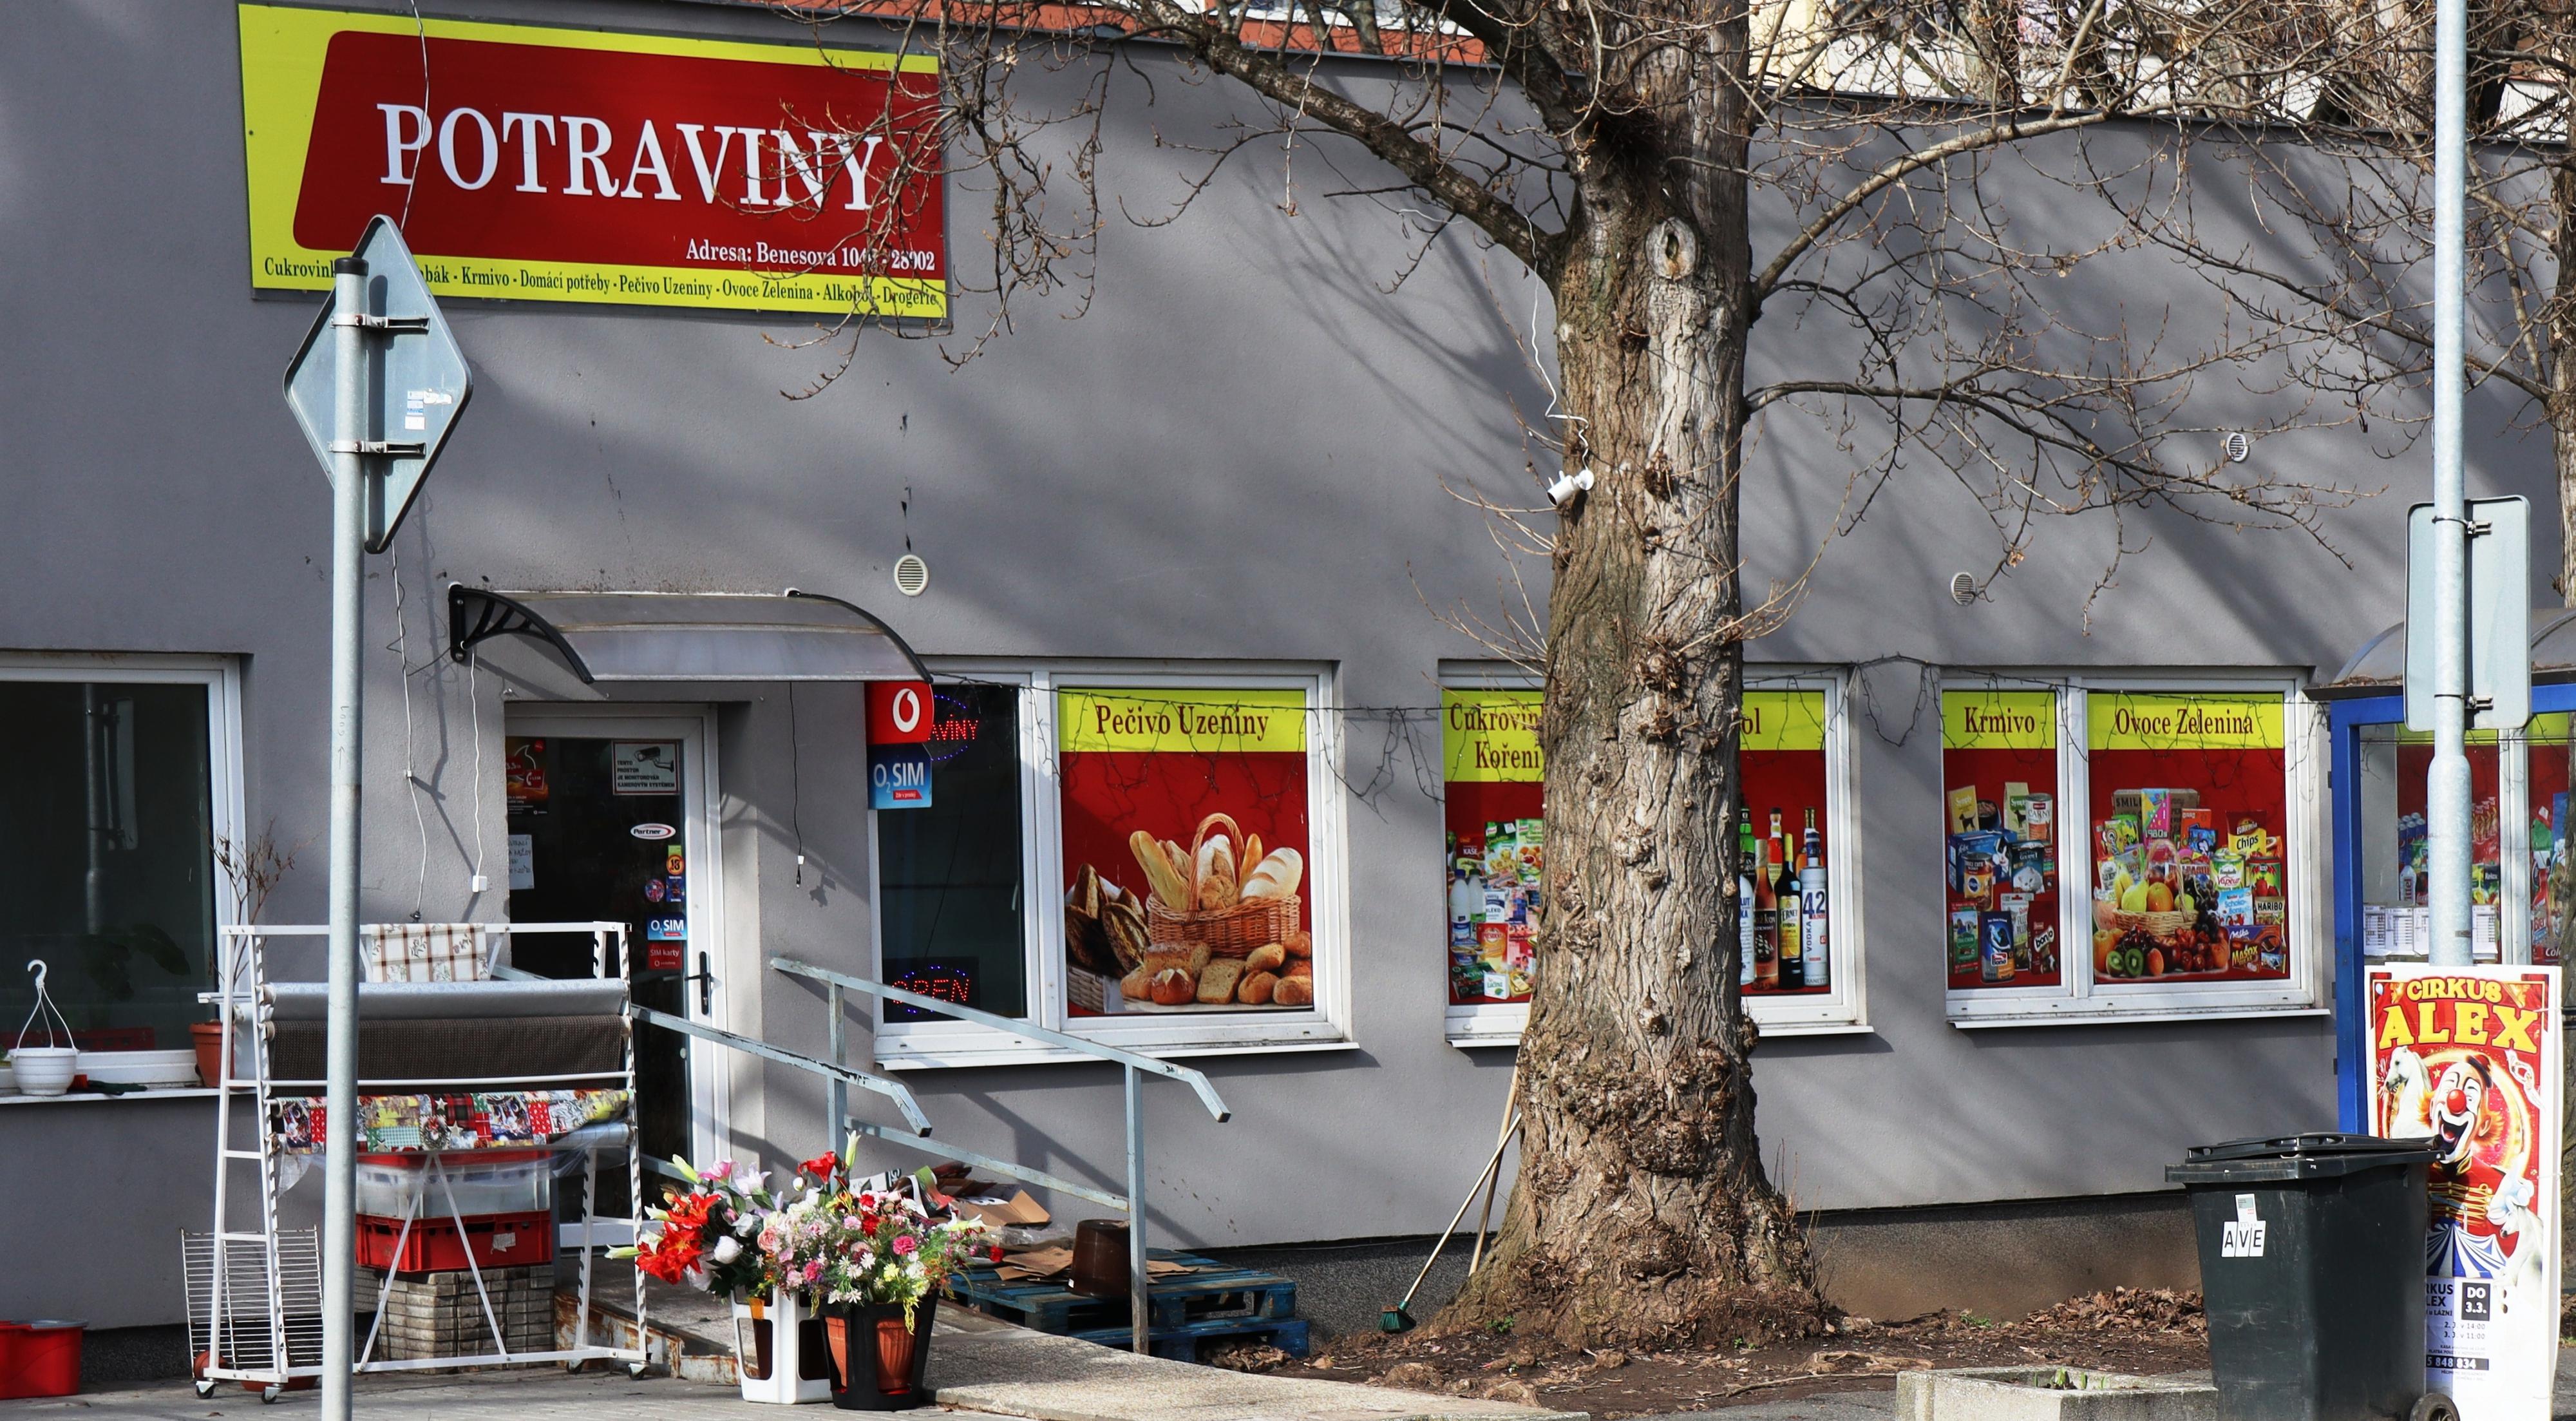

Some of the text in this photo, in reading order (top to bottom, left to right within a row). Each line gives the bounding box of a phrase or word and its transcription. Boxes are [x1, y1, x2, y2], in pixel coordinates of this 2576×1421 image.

[377, 103, 882, 211] POTRAVINY
[686, 238, 752, 263] Adresa:
[756, 242, 837, 267] Benesova
[462, 266, 509, 287] Krmivo
[520, 269, 563, 289] Domácí
[567, 272, 611, 294] potřeby
[619, 275, 659, 294] Pečivo
[663, 277, 712, 300] Uzeniny
[723, 279, 759, 297] Ovoce
[762, 281, 813, 300] Zelenina
[823, 283, 872, 303] Alkohol
[1096, 705, 1269, 741] Pečivo Uzeniny
[1964, 707, 2035, 734] Krmivo
[2116, 709, 2253, 736] Ovoce Zelenina
[893, 762, 924, 787] SIM
[2237, 835, 2259, 850] Chips
[1803, 891, 1826, 919] 42
[2258, 902, 2282, 911] HARIBO
[663, 919, 684, 931] SIM
[663, 949, 679, 957] karty
[891, 978, 971, 1004] OPEN
[2406, 977, 2503, 1004] CIRKUS
[2378, 1001, 2539, 1054] ALEX
[2467, 1286, 2486, 1299] DO
[2465, 1301, 2487, 1314] 3.3.
[2436, 1357, 2454, 1368] 848
[2456, 1358, 2476, 1369] 834
